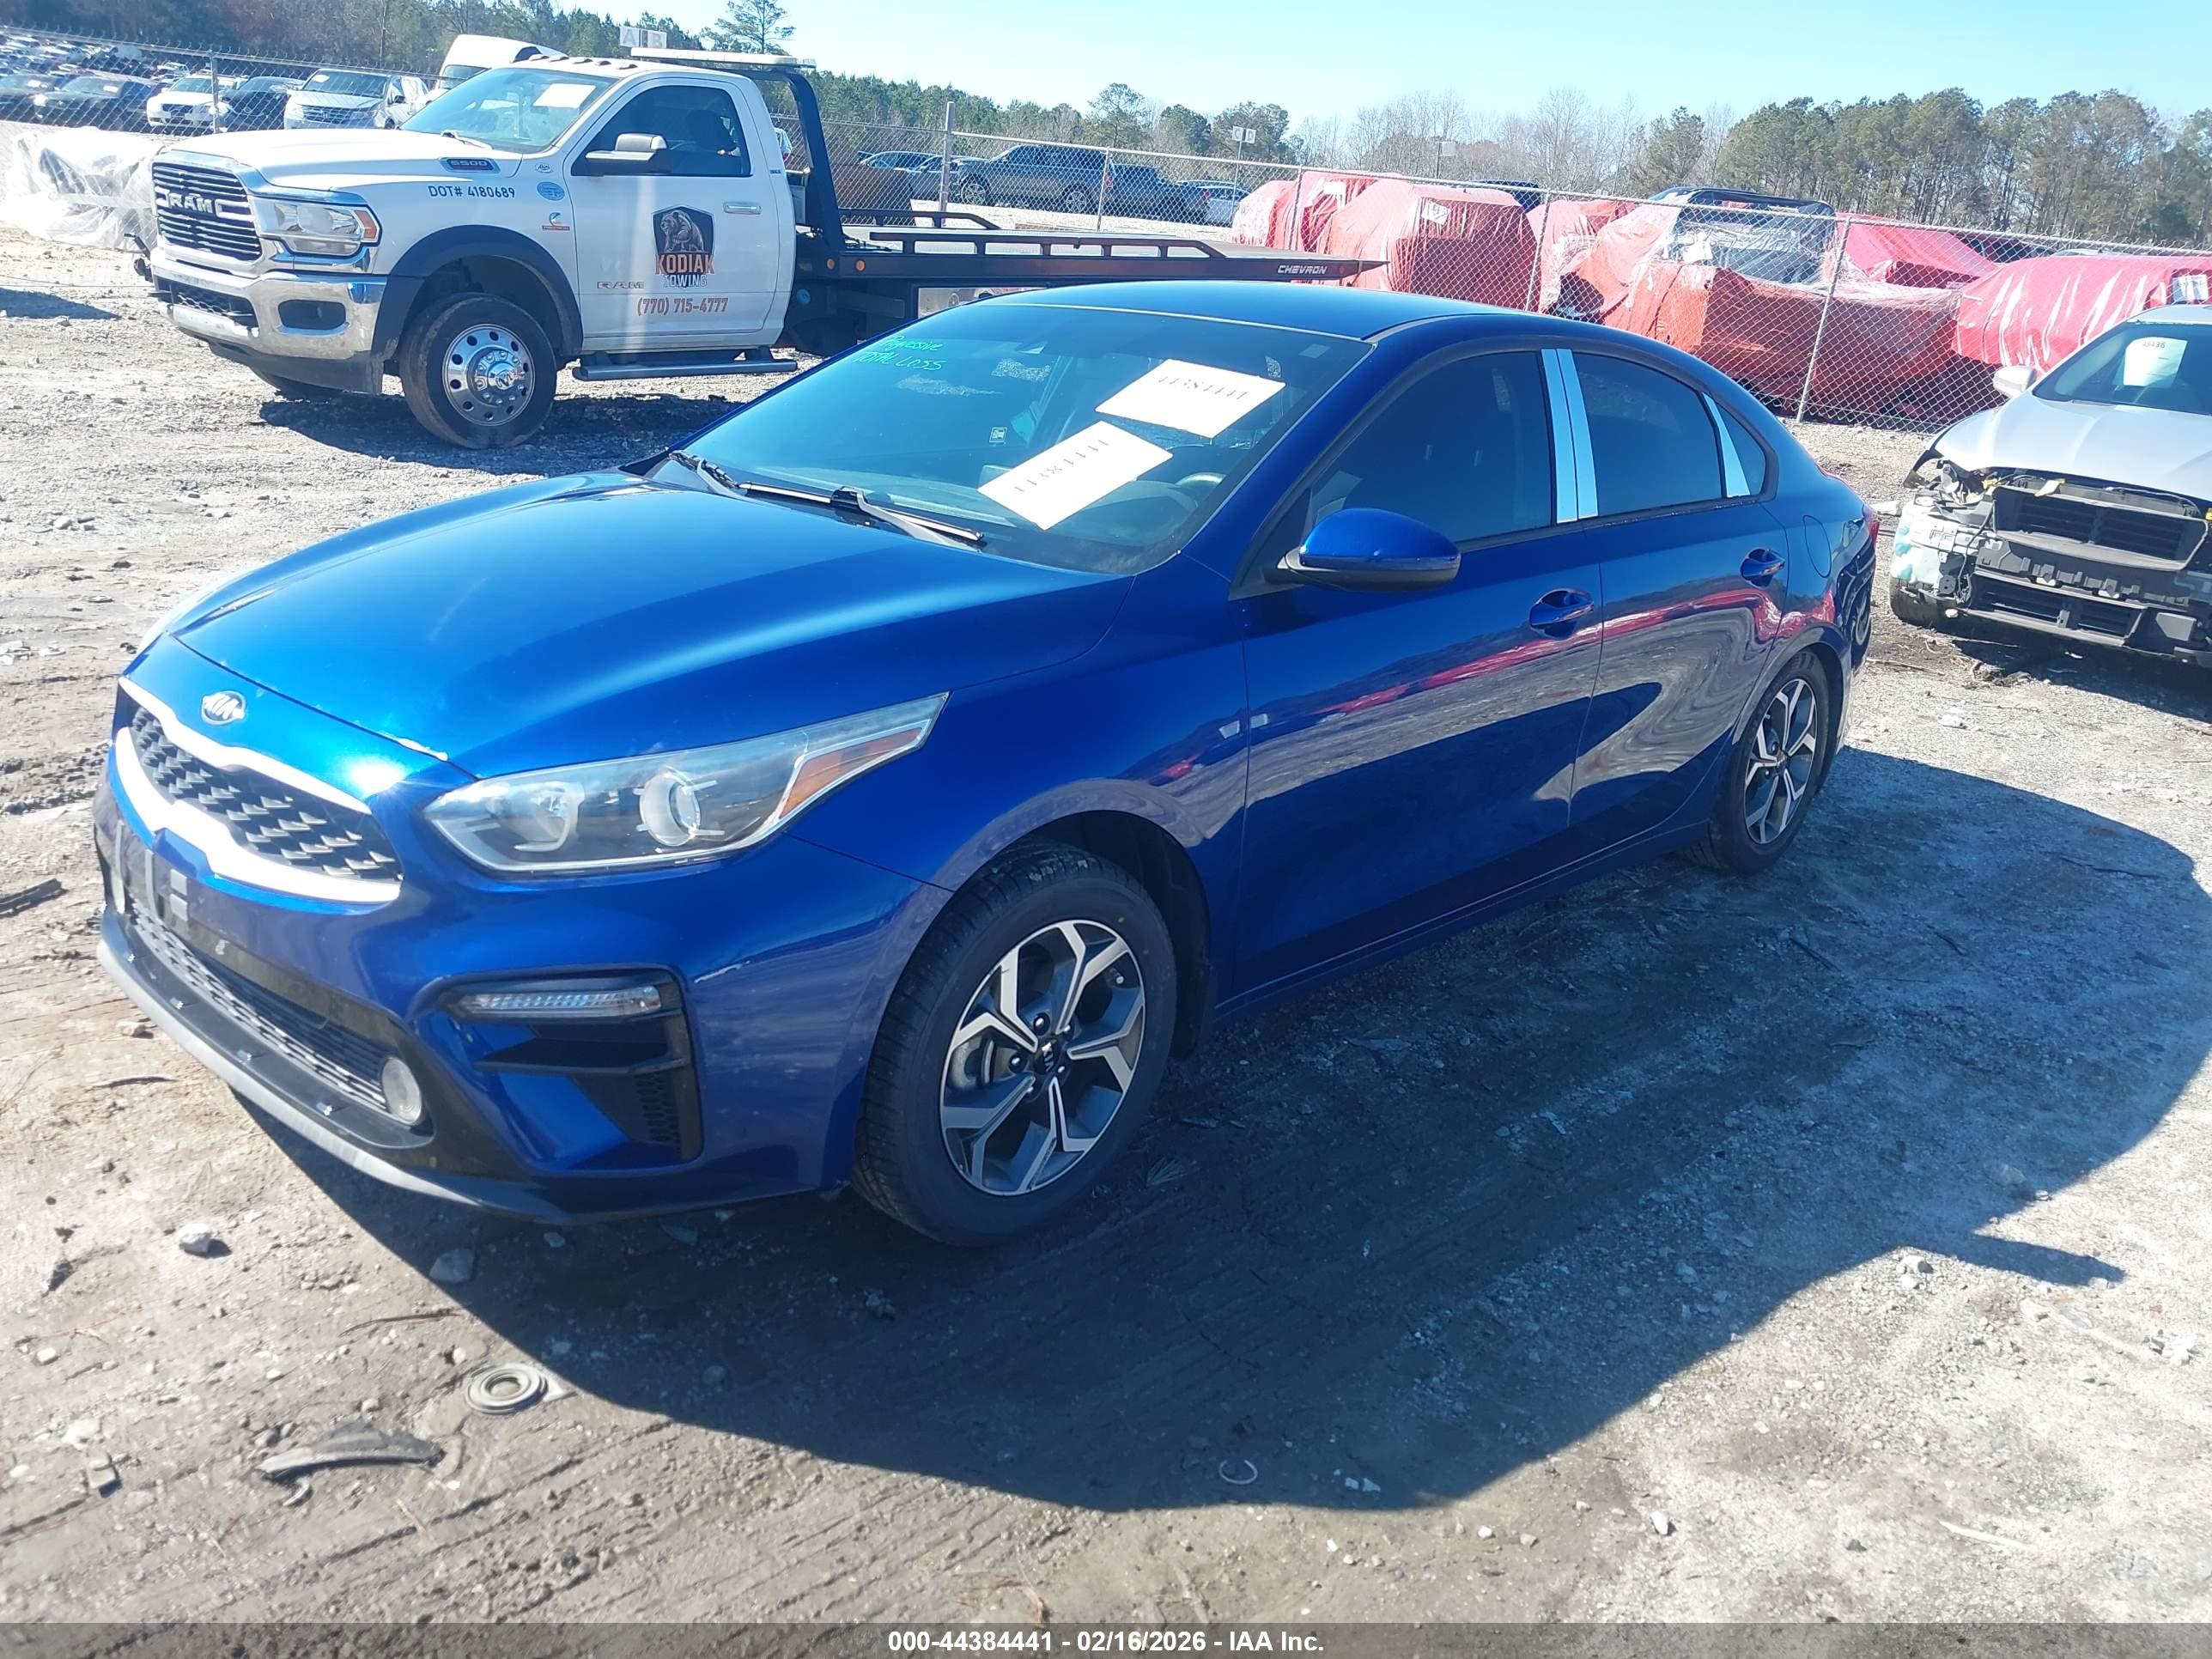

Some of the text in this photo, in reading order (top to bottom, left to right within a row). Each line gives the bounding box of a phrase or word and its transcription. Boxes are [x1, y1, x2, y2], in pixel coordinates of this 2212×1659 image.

[623, 28, 636, 46] A
[428, 185, 515, 198] DOT# 4180689
[169, 193, 214, 214] RAM
[655, 253, 714, 275] KODIAK
[1277, 264, 1328, 275] CHEVRON
[597, 281, 645, 289] RAM
[664, 274, 708, 289] TOWING
[637, 297, 729, 316] (770) 715-4777
